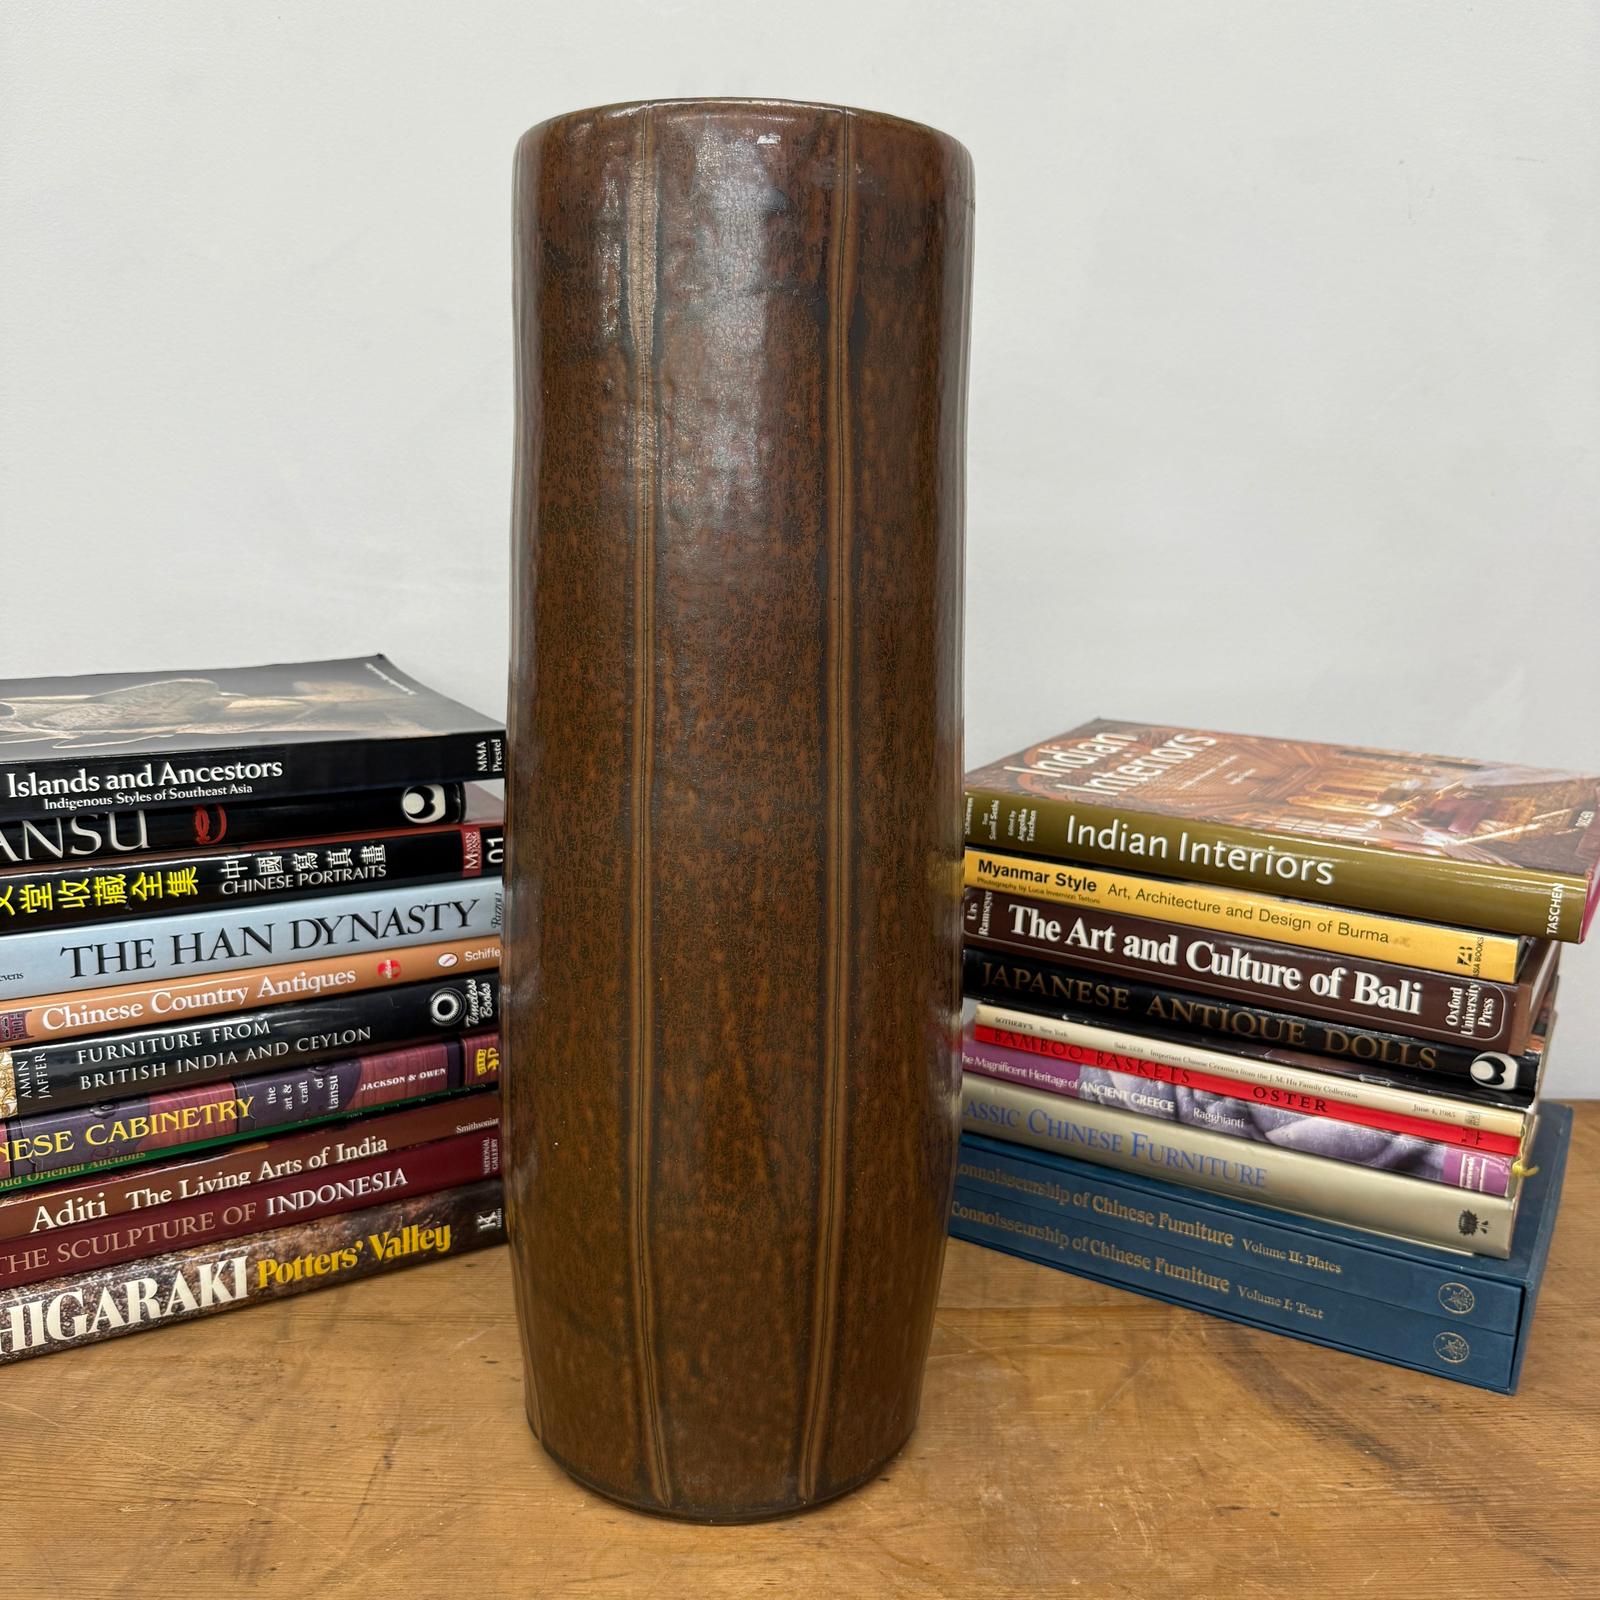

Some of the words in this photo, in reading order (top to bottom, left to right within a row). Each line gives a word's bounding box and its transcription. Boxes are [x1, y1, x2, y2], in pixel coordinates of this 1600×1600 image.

[475, 741, 488, 771] MMA
[490, 738, 503, 772] Prestel
[1003, 731, 1139, 778] Indian
[1056, 732, 1217, 796] Interiors
[7, 768, 100, 798] Islands
[106, 764, 152, 791] and
[159, 760, 283, 786] Ancestors
[44, 797, 113, 811] Indigenous
[116, 792, 152, 806] Styles
[154, 789, 167, 801] of
[169, 785, 228, 799] Southeast
[229, 783, 253, 795] Asia
[1067, 815, 1168, 859] Indian
[1179, 832, 1336, 886] Interiors
[220, 873, 294, 896] CHINESE
[299, 864, 387, 888] PORTRAITS
[977, 877, 1017, 891] Photography
[978, 859, 1051, 884] Myanmar
[1055, 873, 1098, 893] Style
[1108, 884, 1131, 900] Art,
[1136, 888, 1221, 914] Architecture
[1226, 905, 1253, 920] and
[1259, 908, 1312, 931] Design
[1317, 920, 1333, 934] of
[1338, 923, 1389, 944] Burma
[1546, 882, 1565, 936] TASCHEN
[60, 938, 157, 979] THE
[170, 923, 276, 966] HAN
[290, 899, 480, 950] DYNASTY
[1008, 904, 1062, 942] The
[1064, 917, 1117, 953] Art
[1123, 934, 1179, 966] and
[1185, 940, 1303, 991] Culture
[1309, 967, 1347, 999] of
[1350, 970, 1423, 1015] Bali
[1474, 937, 1484, 961] BOOKS
[42, 1003, 144, 1031] Chinese
[151, 987, 250, 1015] Country
[257, 970, 357, 999] Antiques
[478, 982, 493, 1018] Books
[981, 961, 1131, 1011] JAPANESE
[1145, 994, 1308, 1046] ANTIQUE
[1324, 1028, 1437, 1071] DOLLS
[1445, 986, 1463, 1027] Oxford
[1460, 981, 1481, 1036] University
[1477, 998, 1494, 1028] Press
[77, 1032, 203, 1065] FURNITURE
[211, 1020, 272, 1046] FROM
[80, 1063, 167, 1091] BRITISH
[178, 1051, 239, 1074] INDIA
[246, 1041, 289, 1063] AND
[296, 1026, 372, 1052] CEYLON
[17, 1060, 33, 1099] AMIN
[34, 1052, 53, 1100] JAFFER
[360, 1076, 406, 1092] JACKSON
[408, 1074, 417, 1083] &
[419, 1068, 447, 1079] OWEN
[974, 1058, 1027, 1079] Magnificent
[1029, 1068, 1068, 1089] Heritage
[1068, 1079, 1080, 1089] of
[1080, 1081, 1130, 1099] ANCIENT
[1130, 1092, 1175, 1113] GREECE
[1095, 1049, 1191, 1084] BASKETS
[85, 1096, 255, 1147] CABINETRY
[1193, 1107, 1245, 1129] Ragghianti
[1253, 1086, 1328, 1113] OSTER
[1027, 1108, 1124, 1153] CHINESE
[1130, 1131, 1268, 1188] FURNITURE
[30, 1193, 109, 1233] Aditi
[125, 1188, 173, 1211] The
[179, 1171, 252, 1200] Living
[258, 1159, 303, 1182] Arts
[309, 1151, 330, 1168] of
[335, 1136, 389, 1162] India
[58, 1211, 217, 1263] SCULPTURE
[222, 1202, 258, 1226] OF
[267, 1167, 409, 1217] INDONESIA
[1073, 1191, 1091, 1208] of
[1092, 1195, 1156, 1226] Chinese
[1157, 1212, 1236, 1248] Furniture
[1242, 1238, 1287, 1260] Volume
[1305, 1254, 1343, 1274] Plates
[368, 1223, 451, 1263] Valley
[1072, 1236, 1090, 1252] of
[1090, 1240, 1152, 1270] Chinese
[1154, 1256, 1231, 1293] Furniture
[1237, 1284, 1281, 1307] Volume
[1295, 1301, 1324, 1319] Text
